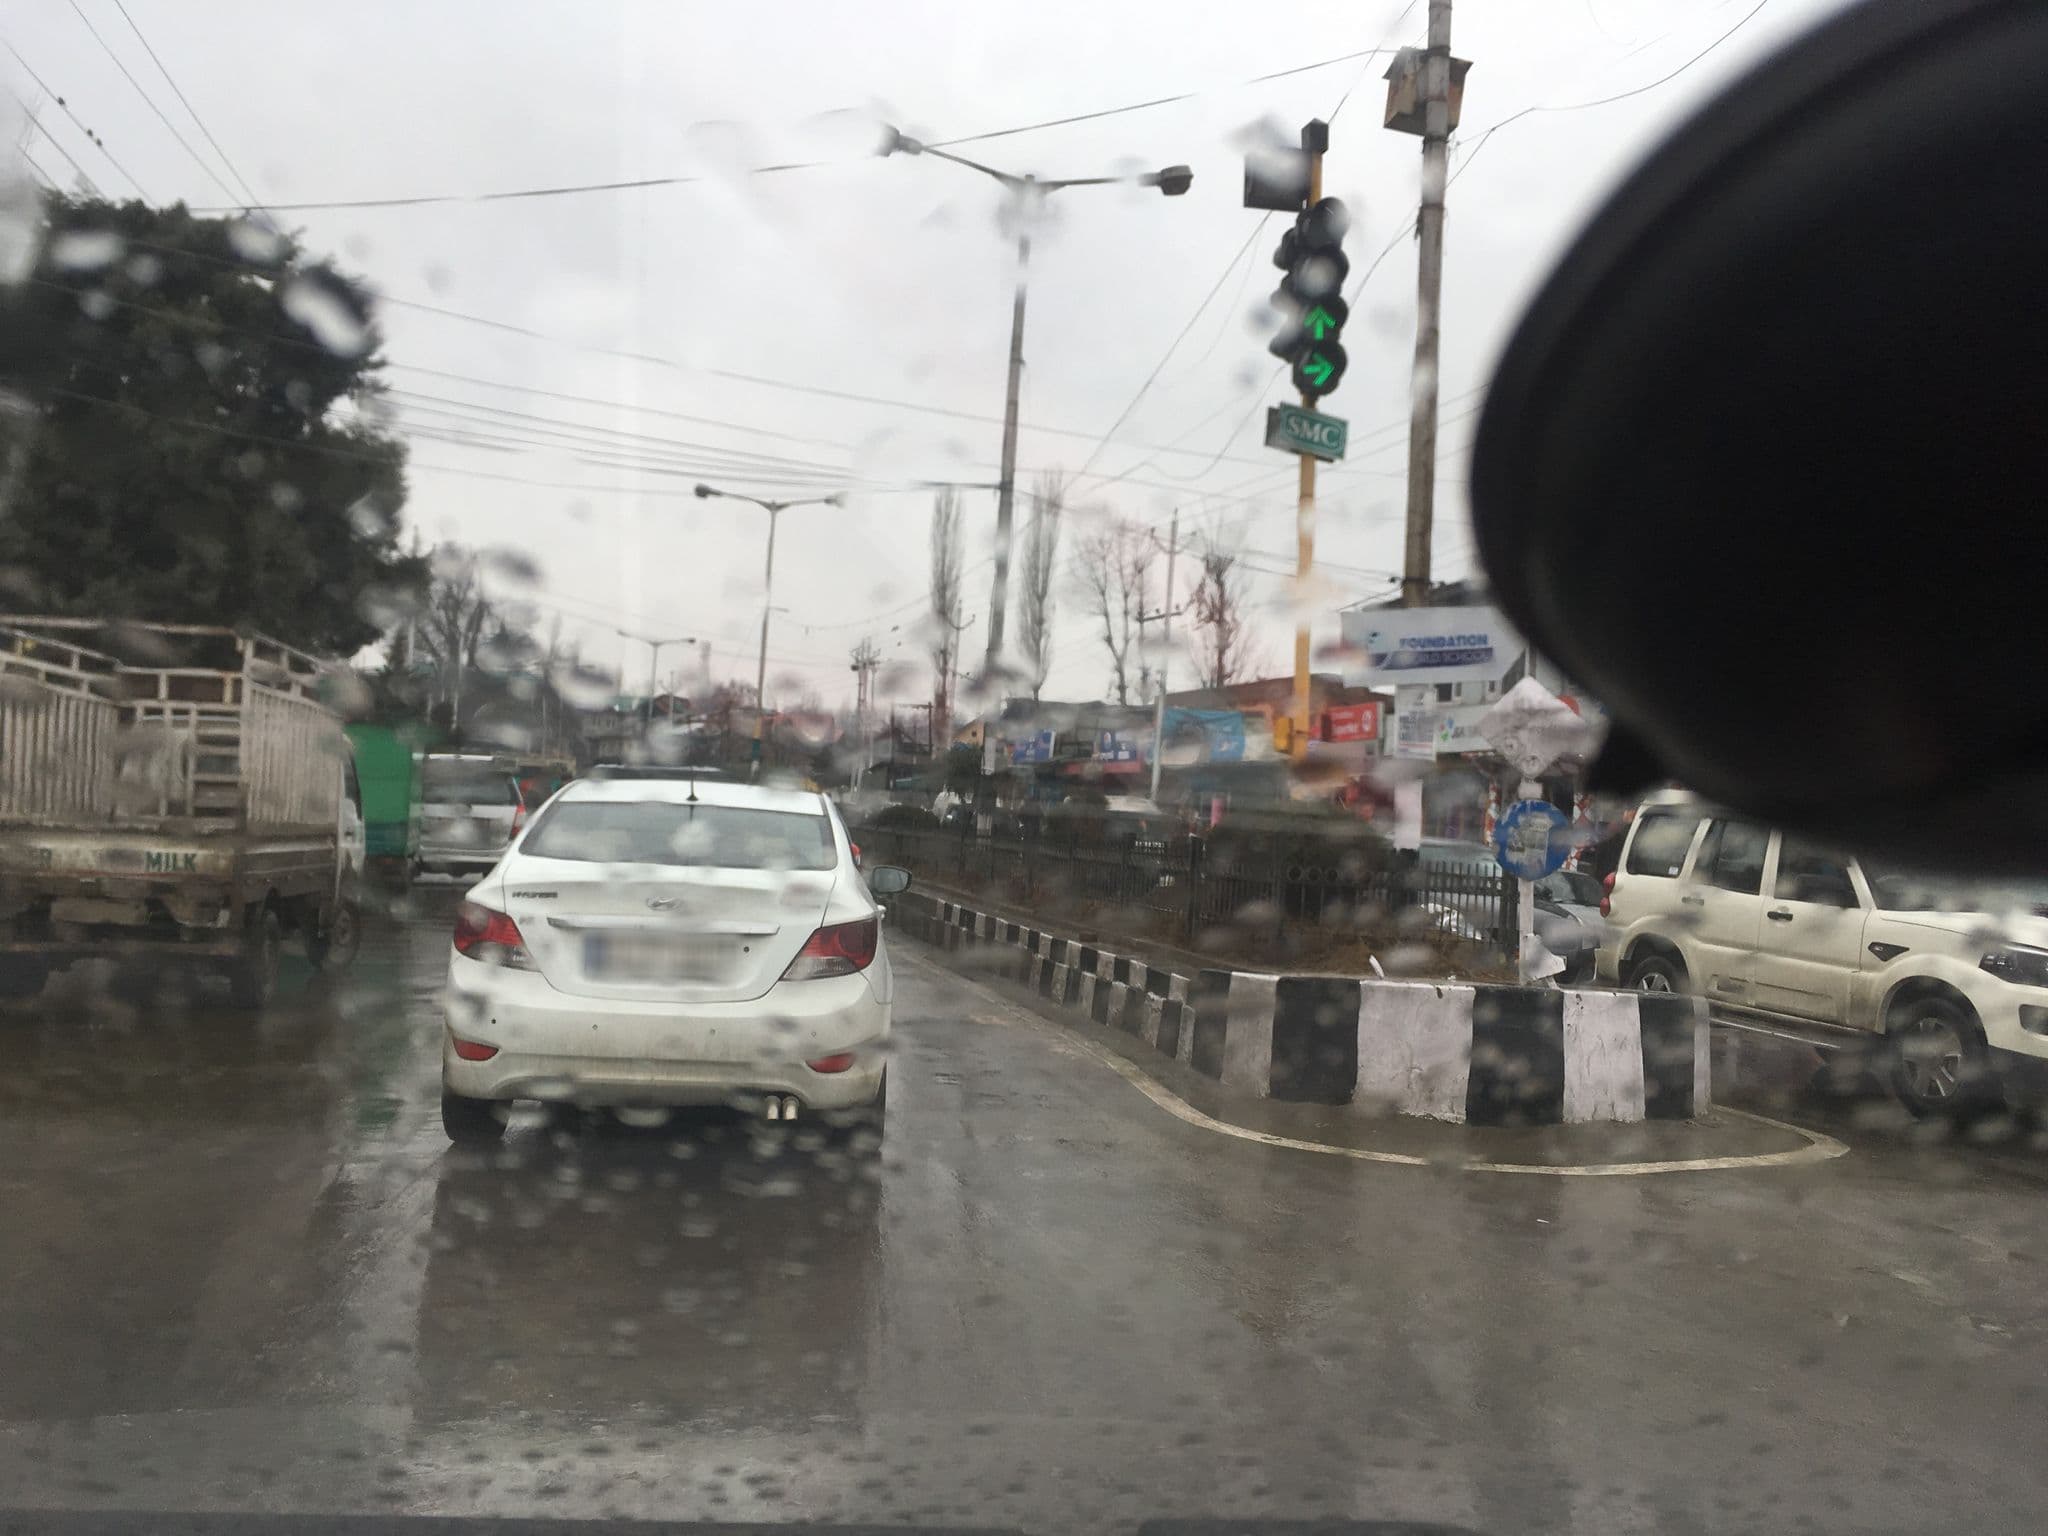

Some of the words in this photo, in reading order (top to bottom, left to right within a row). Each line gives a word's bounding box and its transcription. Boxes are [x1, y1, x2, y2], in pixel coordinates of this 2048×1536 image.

[1287, 415, 1340, 447] SMC
[1400, 634, 1489, 649] FOUNDATION
[145, 850, 197, 872] MILK
